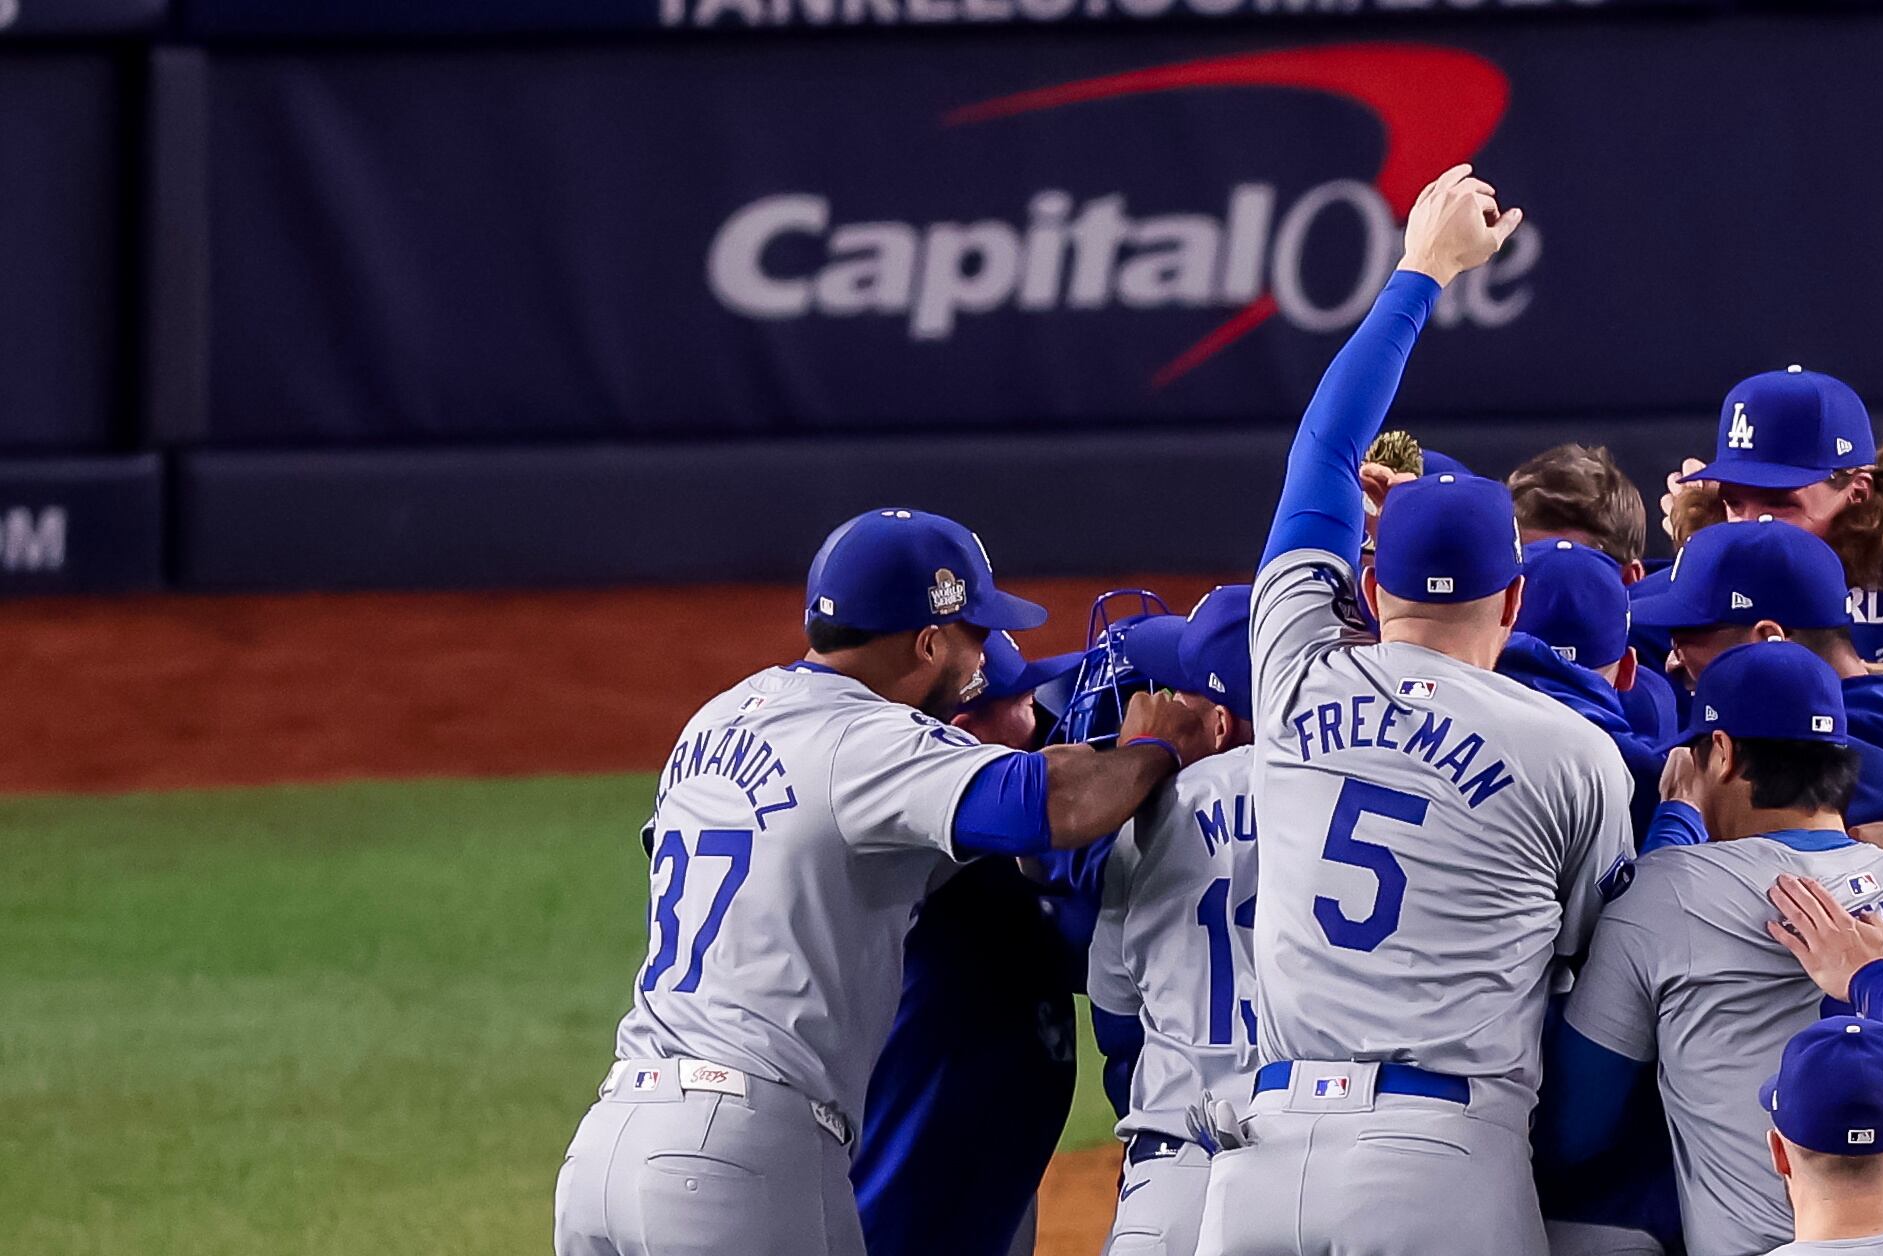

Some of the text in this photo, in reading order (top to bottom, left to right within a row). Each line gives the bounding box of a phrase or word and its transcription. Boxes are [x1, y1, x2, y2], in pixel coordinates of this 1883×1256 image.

[1727, 402, 1755, 449] LA
[1293, 695, 1515, 810] FREEMAN
[642, 828, 754, 993] 37
[1313, 776, 1432, 953] 5
